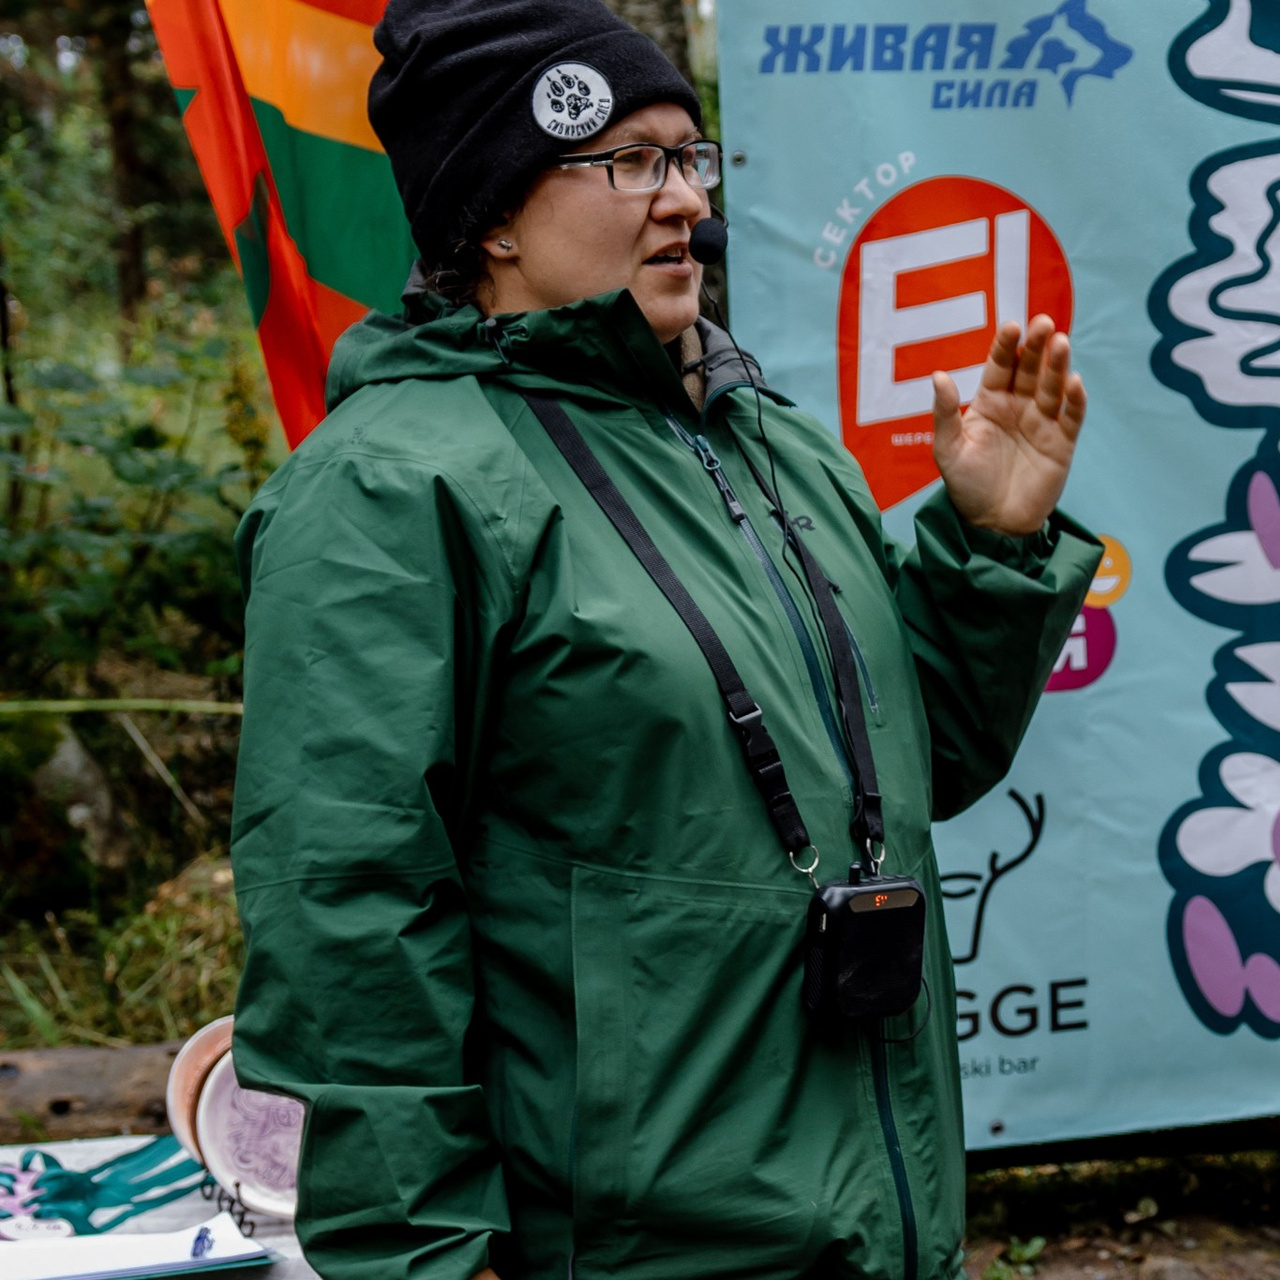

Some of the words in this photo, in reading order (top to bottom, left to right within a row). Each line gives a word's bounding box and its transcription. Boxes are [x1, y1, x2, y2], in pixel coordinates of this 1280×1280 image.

[759, 23, 997, 73] ЖИВАЯ
[931, 79, 1037, 109] СИЛА
[547, 118, 599, 136] СИБИРСКИЙ
[813, 150, 916, 269] СЕКТОР
[892, 433, 934, 446] ШЕРЕ
[956, 976, 1088, 1042] GGE
[999, 1054, 1038, 1075] bar
